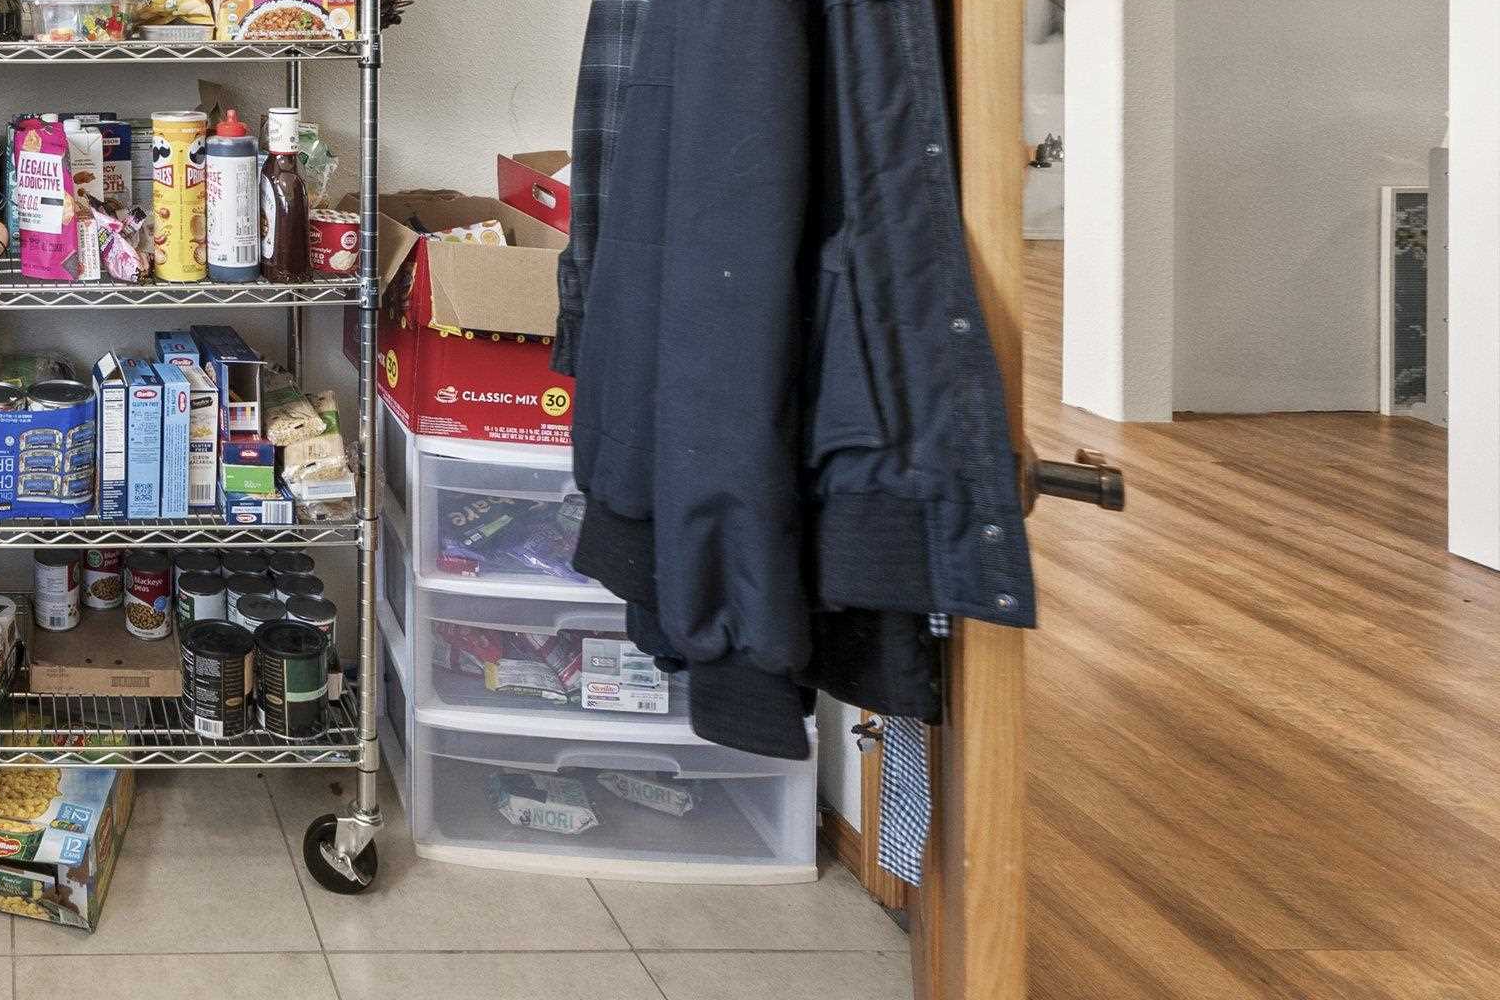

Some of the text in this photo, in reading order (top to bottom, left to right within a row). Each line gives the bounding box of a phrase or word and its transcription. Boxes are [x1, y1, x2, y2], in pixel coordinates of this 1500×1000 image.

[20, 158, 58, 178] LEGALLY
[18, 176, 61, 192] ADDICTIVE
[462, 390, 566, 408] CLASSIC MIX 30
[531, 806, 574, 830] NORI
[66, 838, 82, 852] 12
